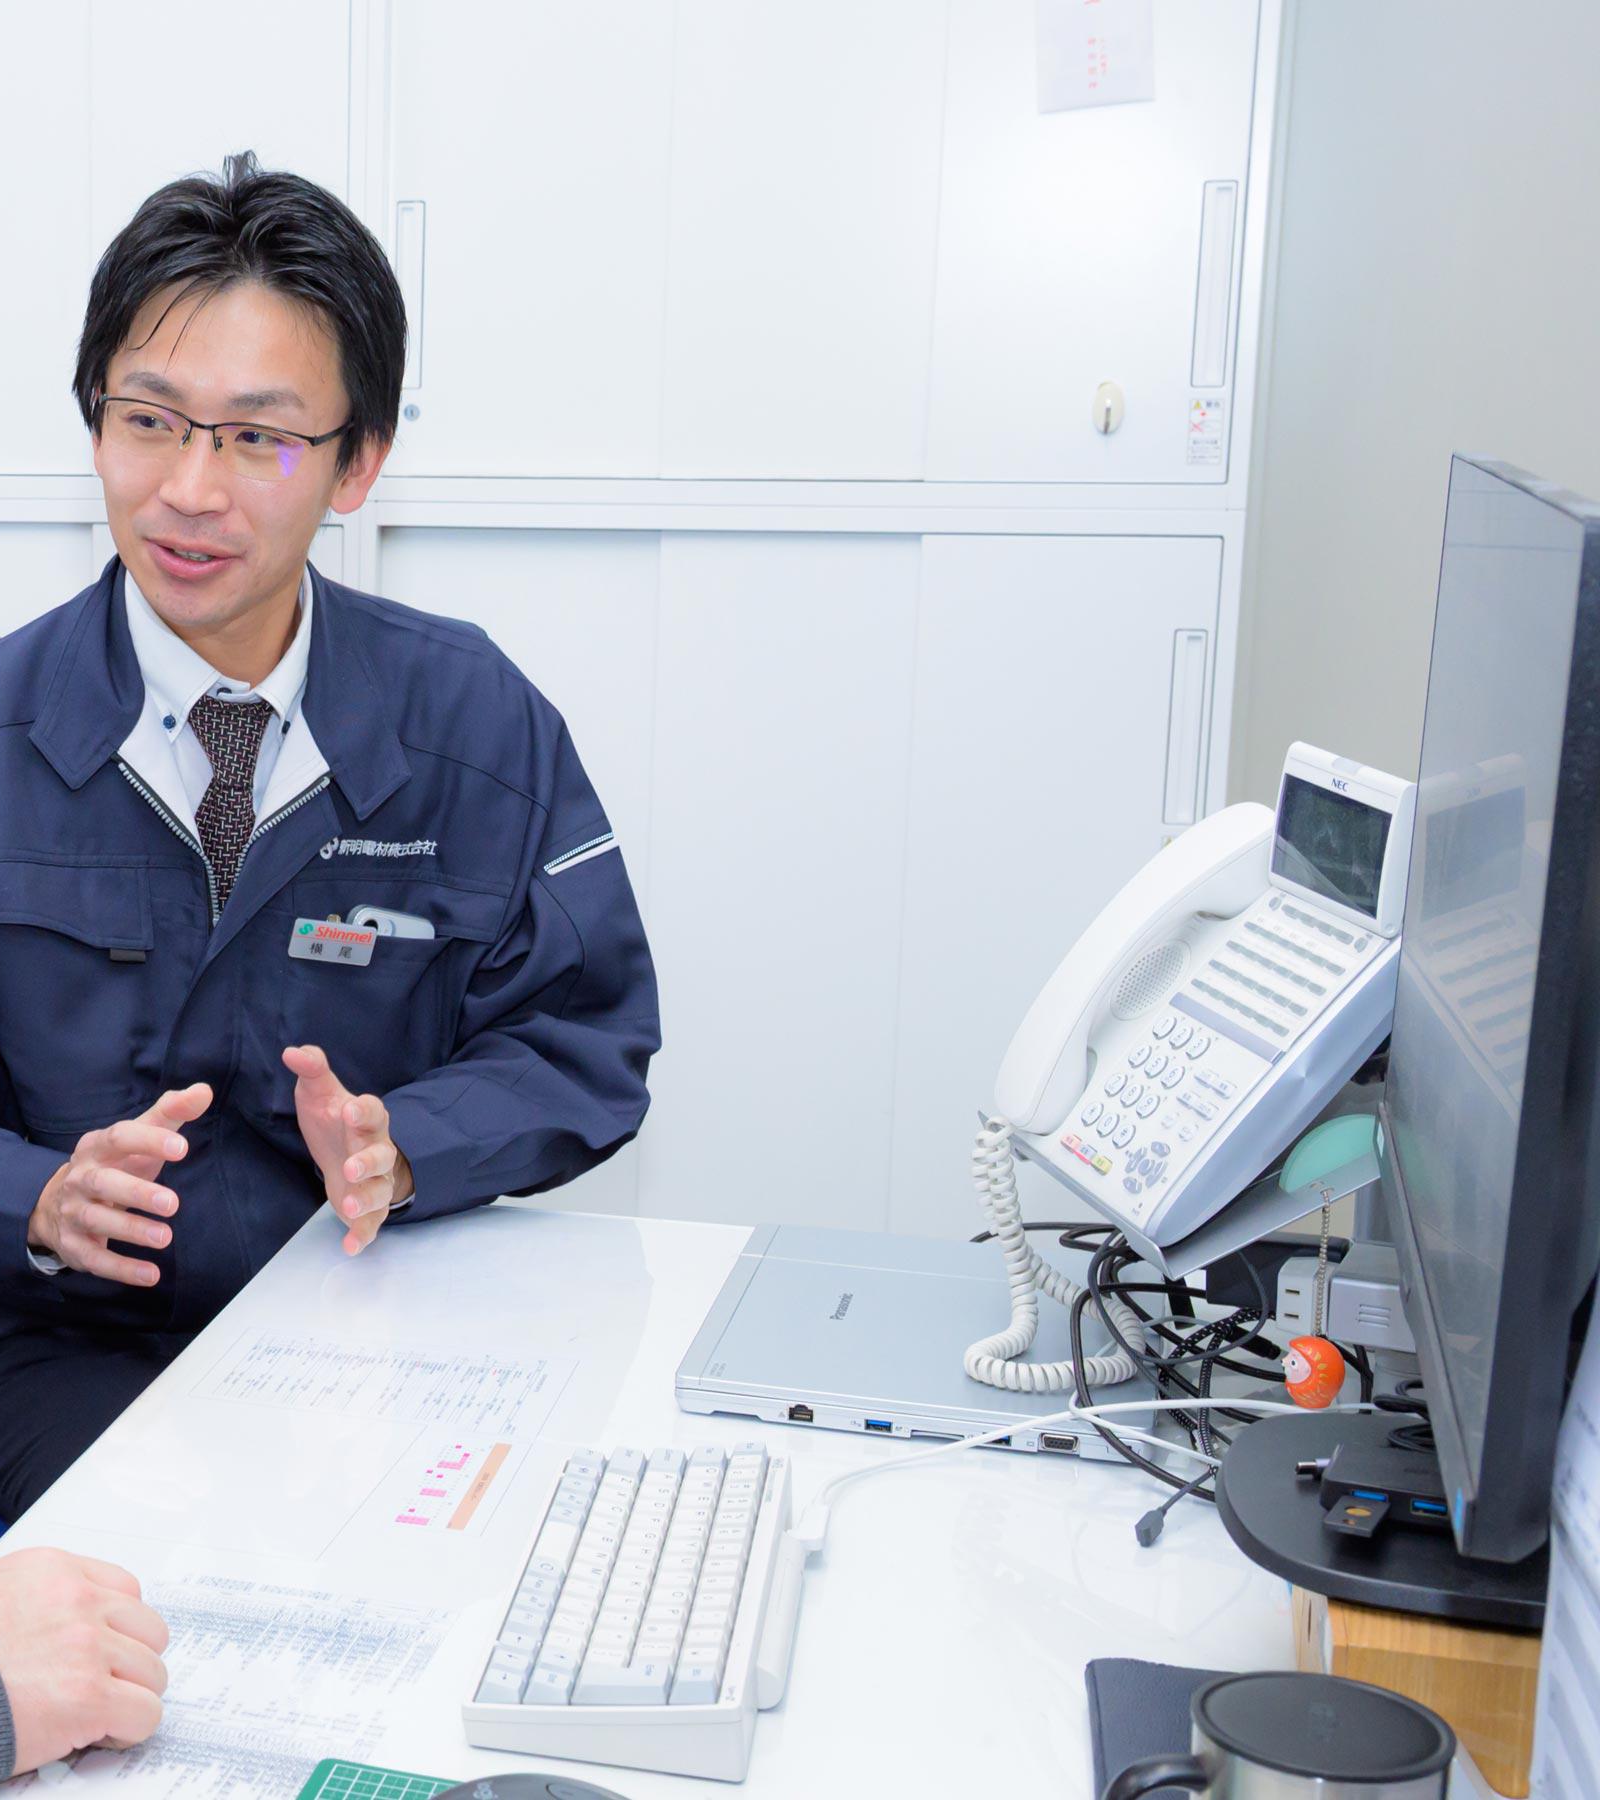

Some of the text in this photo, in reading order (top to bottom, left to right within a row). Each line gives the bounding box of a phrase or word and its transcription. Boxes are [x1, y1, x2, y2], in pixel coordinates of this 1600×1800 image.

[1331, 778, 1348, 792] NEC
[315, 925, 372, 944] Shinmei
[829, 1292, 854, 1320] Panasonic
